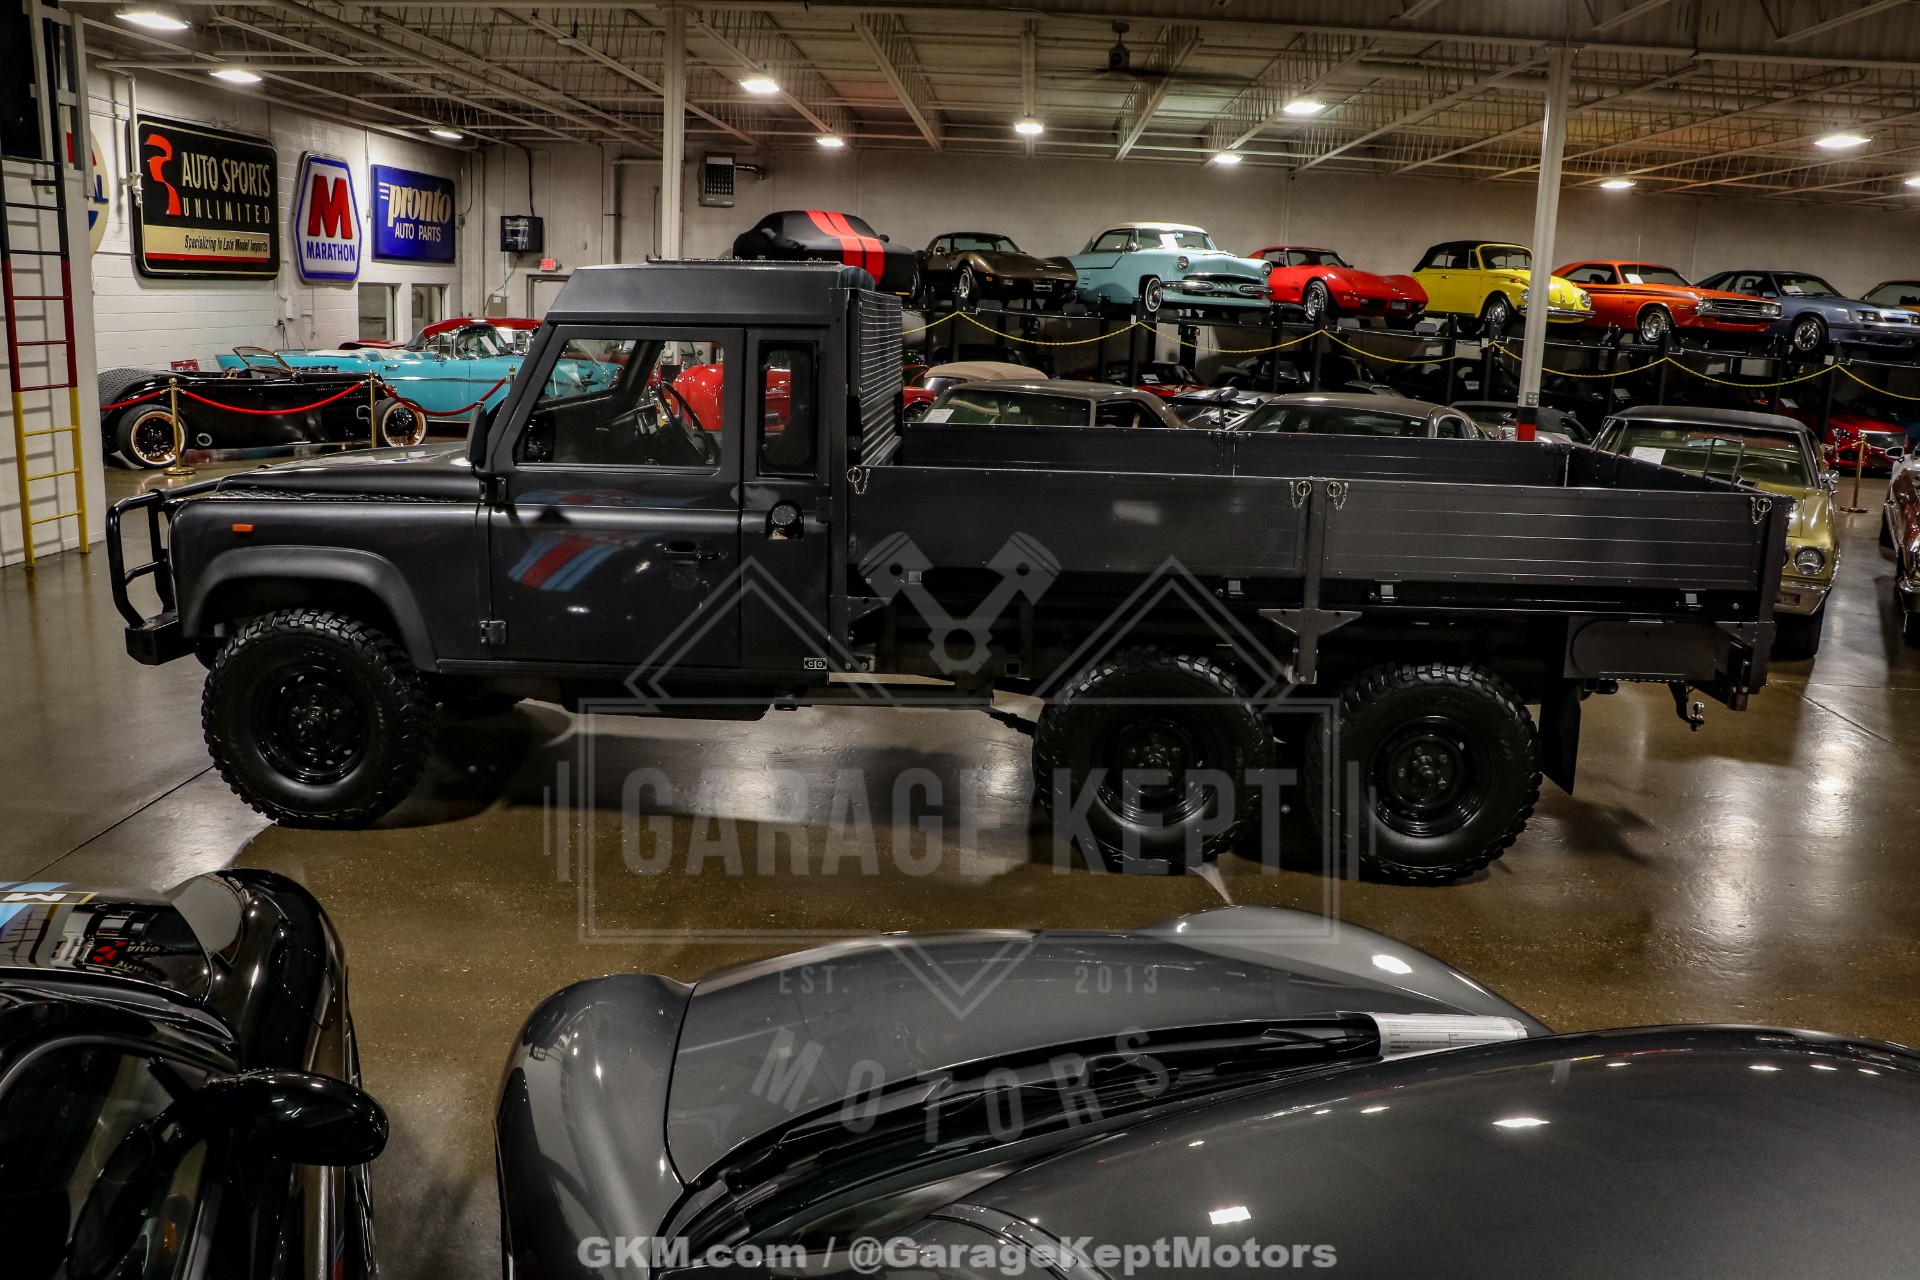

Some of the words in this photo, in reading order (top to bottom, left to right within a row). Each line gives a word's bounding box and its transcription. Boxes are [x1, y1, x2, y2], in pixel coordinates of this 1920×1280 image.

[182, 152, 219, 191] AUTO
[222, 158, 270, 197] SPORTS
[182, 197, 270, 224] UNLIMITED
[307, 174, 353, 239] M
[387, 184, 452, 228] pronto
[184, 234, 217, 252] Specializing
[223, 237, 234, 251] Late
[234, 237, 249, 252] Model
[250, 238, 268, 254] Imports
[394, 222, 415, 240] AUTO
[418, 224, 442, 243] PARTS
[306, 240, 355, 262] MARATHON
